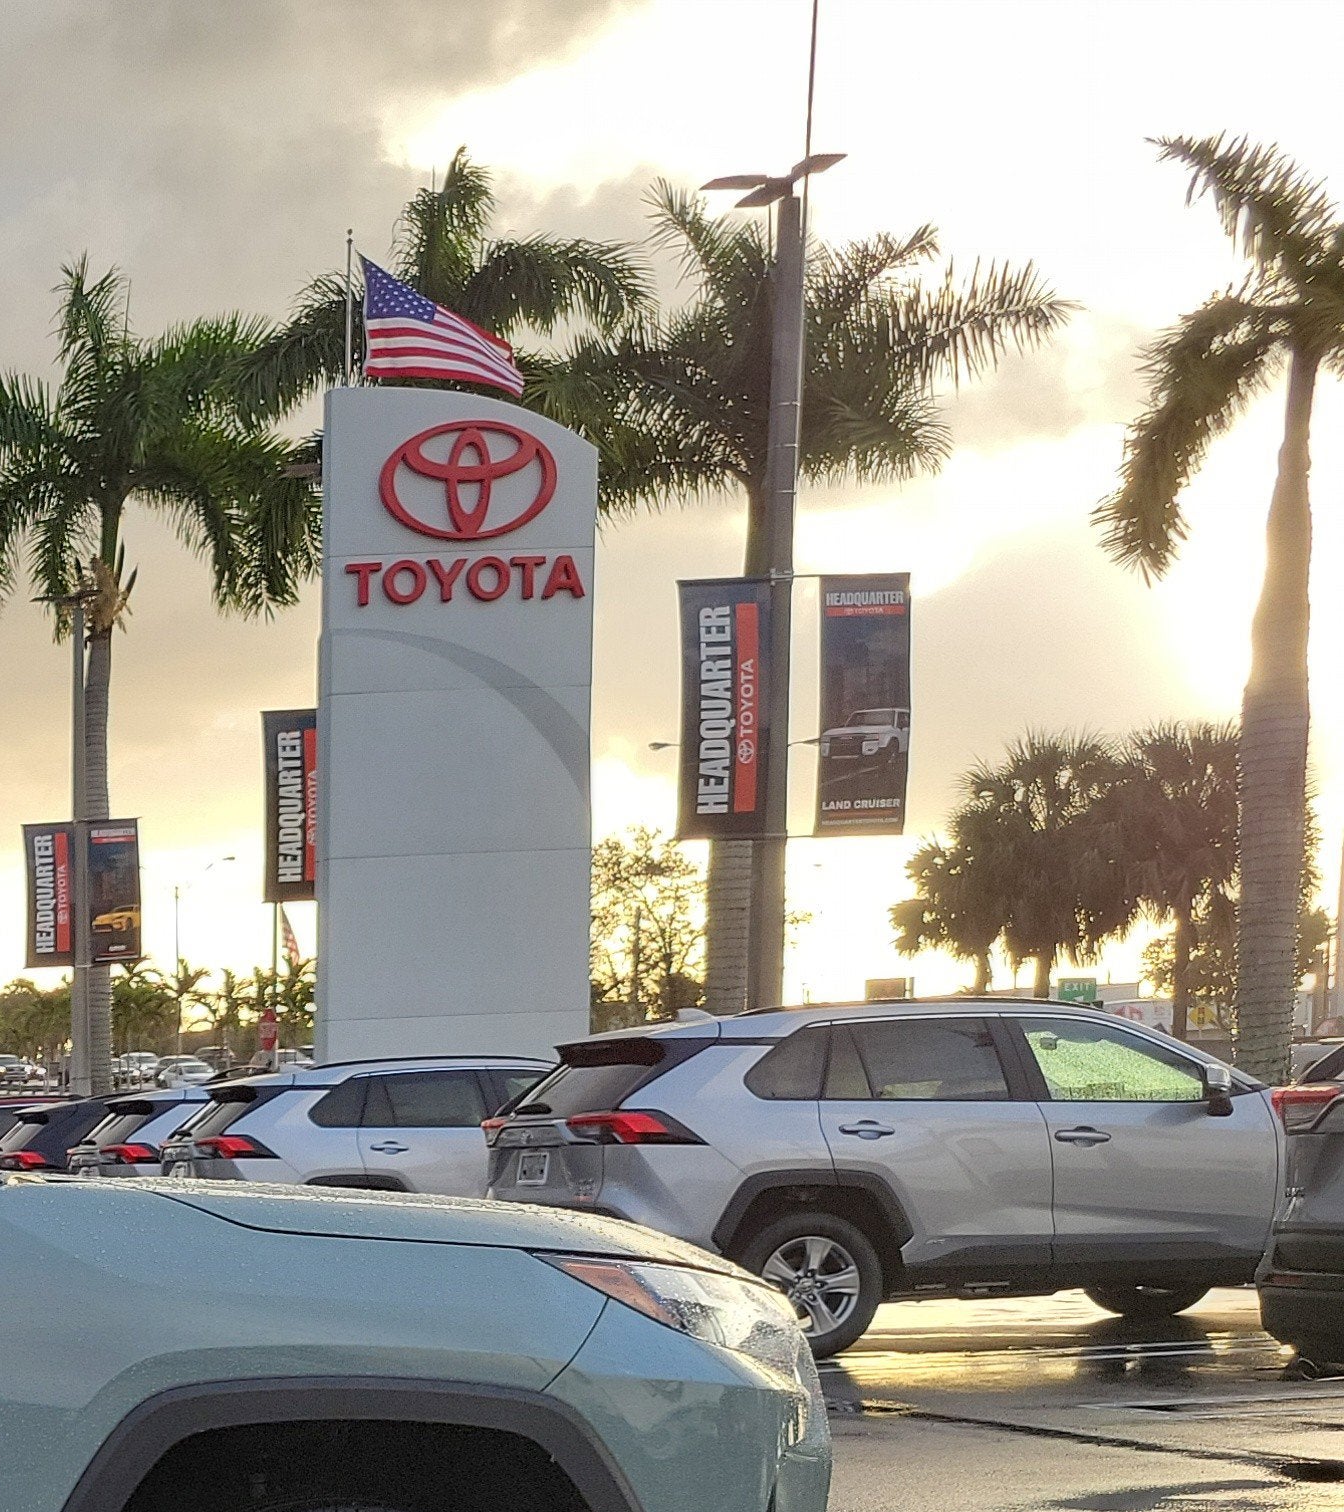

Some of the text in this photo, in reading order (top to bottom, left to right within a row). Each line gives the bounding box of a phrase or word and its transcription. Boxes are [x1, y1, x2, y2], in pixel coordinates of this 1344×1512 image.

[344, 555, 585, 607] TOYOTA
[825, 591, 904, 606] HEADQUARTER
[854, 607, 884, 615] TOYOTA
[697, 605, 736, 814] HEADQUARTER
[740, 658, 754, 737] TOYOTA
[277, 730, 306, 883] HEADQUARTER
[822, 798, 900, 811] LAND CRUISER
[34, 834, 56, 954] HEADQUARTER
[57, 866, 69, 910] TOYOTA
[1064, 982, 1090, 992] EXIT
